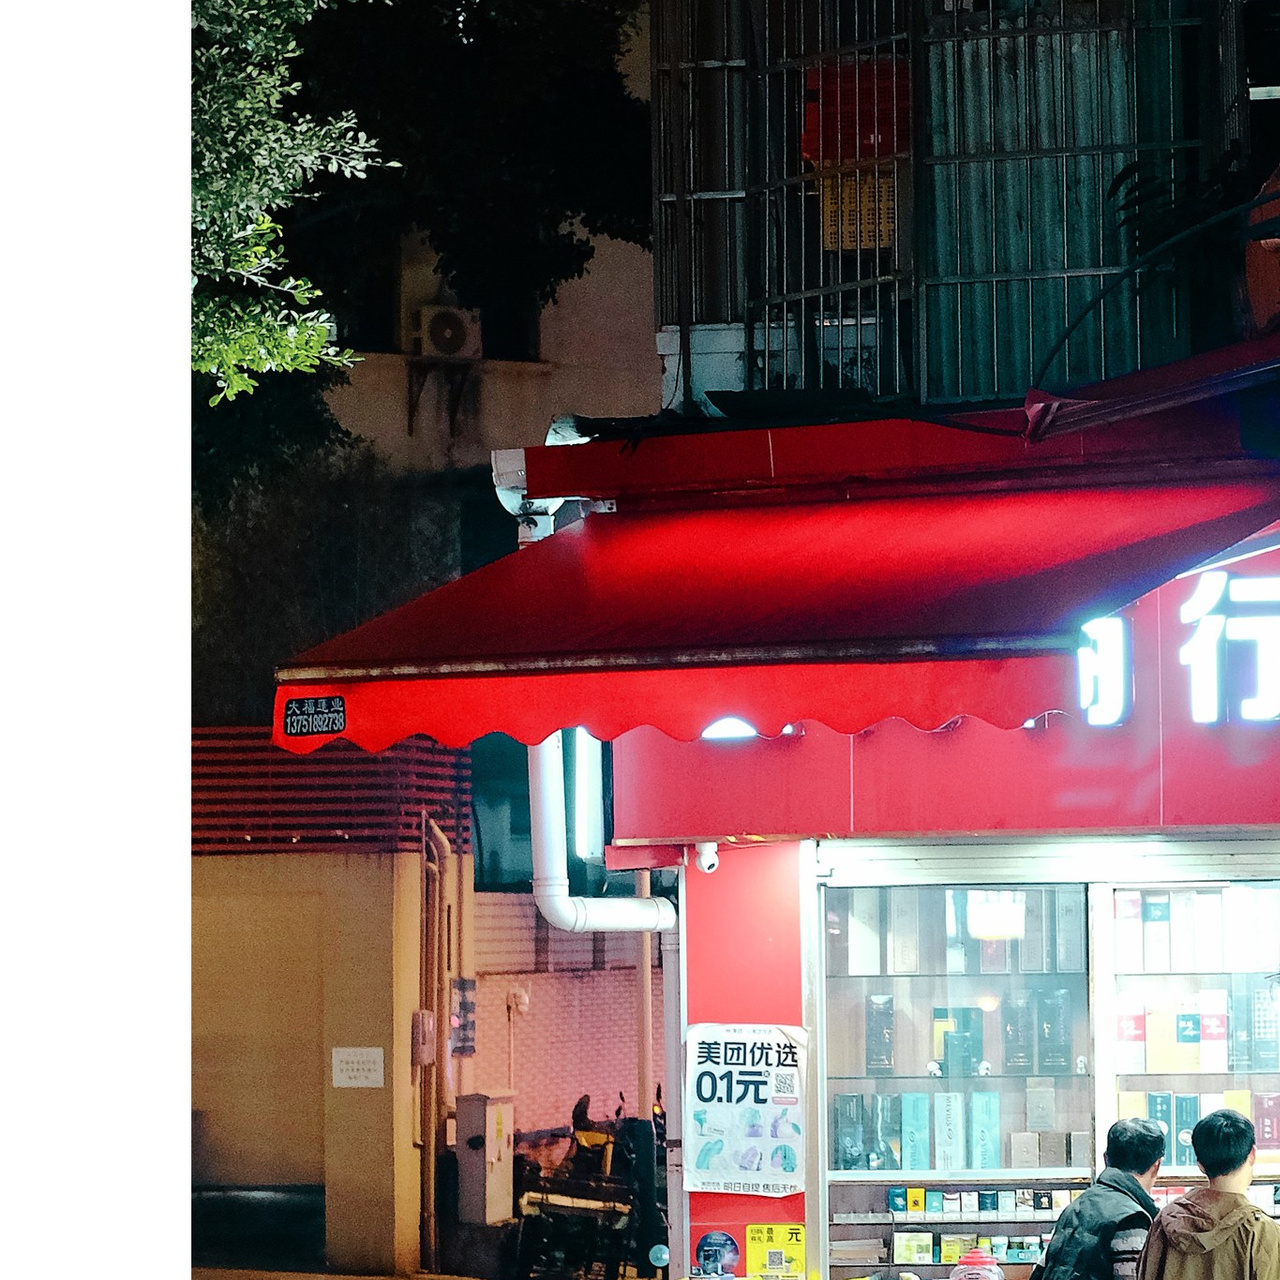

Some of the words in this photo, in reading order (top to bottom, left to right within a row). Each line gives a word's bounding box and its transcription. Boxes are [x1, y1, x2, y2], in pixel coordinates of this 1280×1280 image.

[286, 712, 345, 734] 13751892738
[697, 1040, 799, 1068] 美团优选
[787, 1227, 802, 1243] 元
